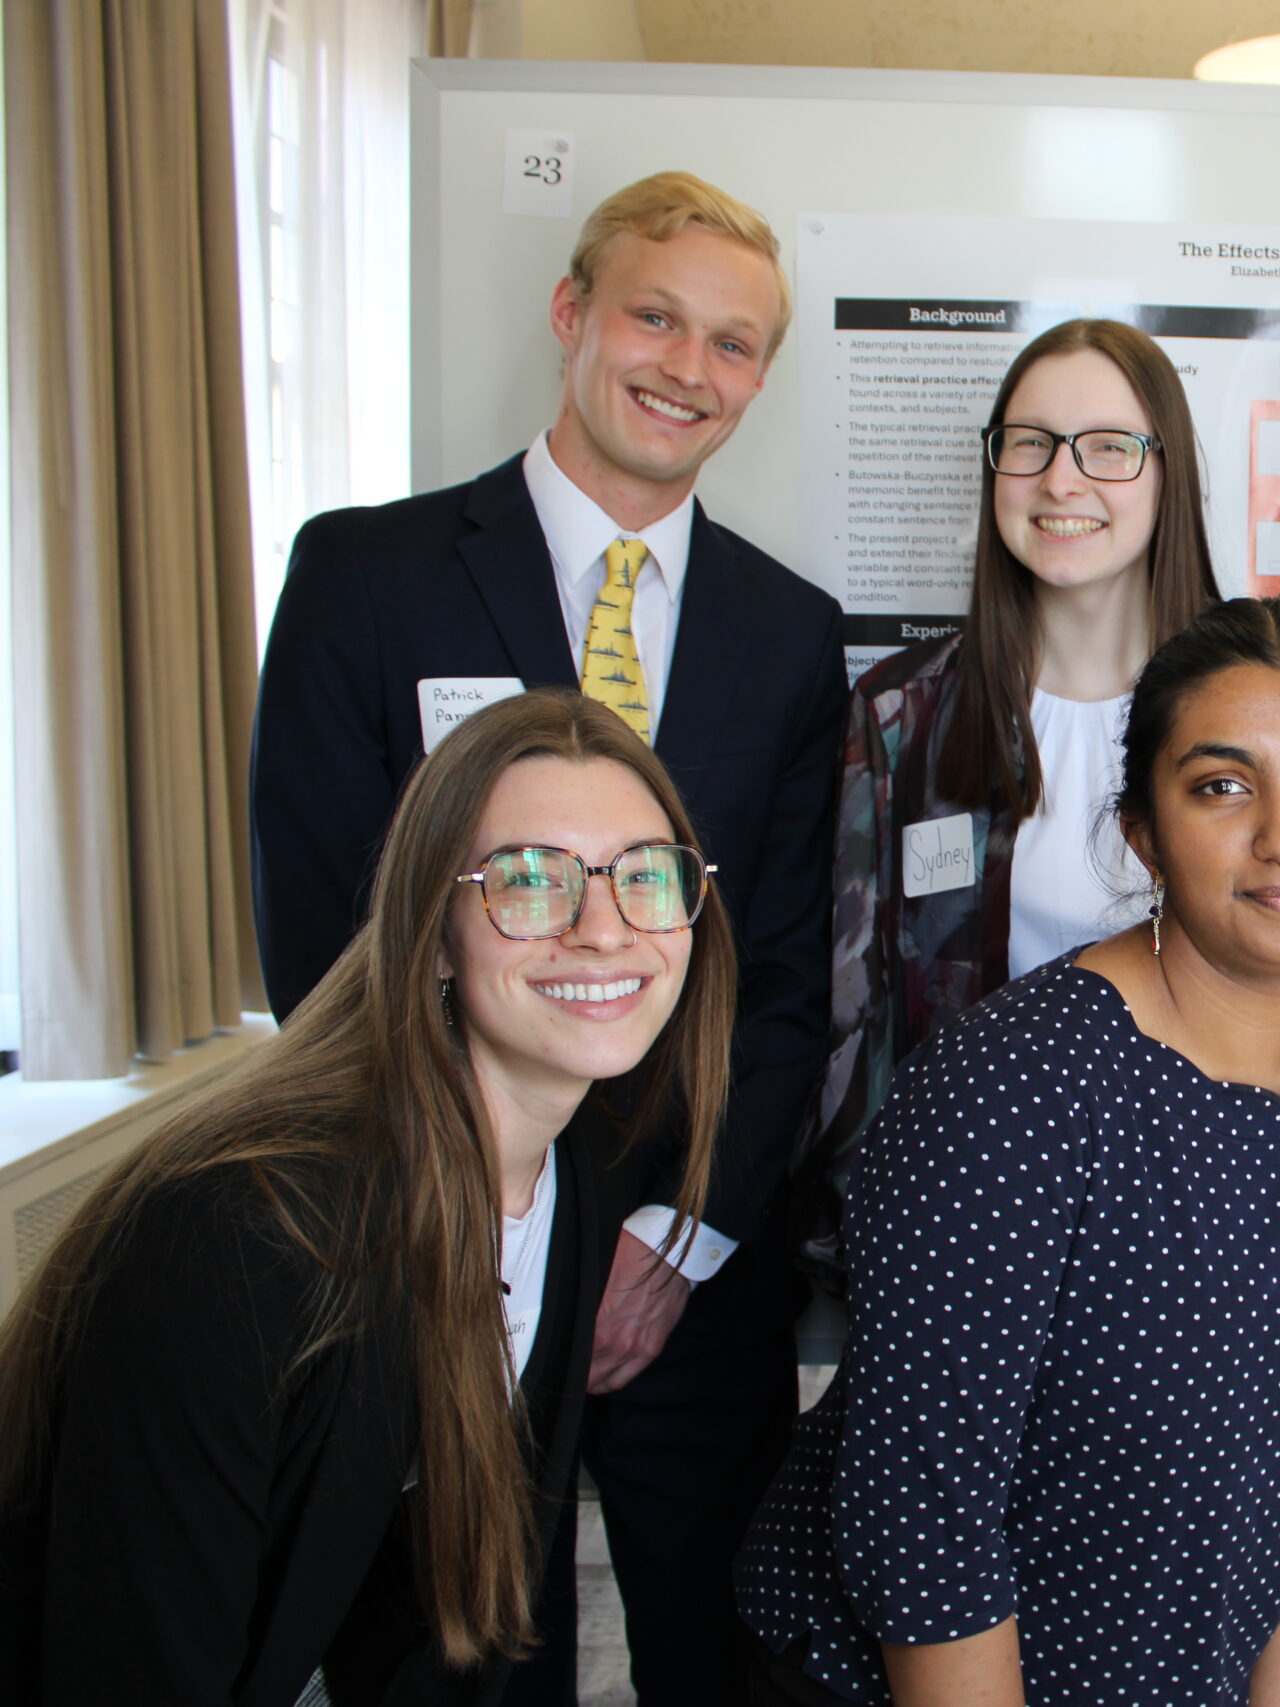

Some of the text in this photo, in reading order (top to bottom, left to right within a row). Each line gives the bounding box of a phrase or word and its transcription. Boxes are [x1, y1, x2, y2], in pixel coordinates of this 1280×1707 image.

[523, 155, 561, 186] 23
[1179, 241, 1213, 257] The
[1218, 243, 1279, 260] Effects
[910, 306, 1006, 325] Background
[850, 340, 1023, 352] Attempting to retrieve informatio
[850, 355, 897, 365] retention
[900, 356, 954, 368] compared
[956, 356, 967, 365] to
[850, 373, 870, 383] This
[874, 373, 920, 384] retrieval
[923, 375, 968, 386] practice
[849, 388, 879, 398] found
[882, 390, 918, 398] across
[929, 389, 964, 401] variety
[967, 390, 976, 399] of
[849, 403, 970, 415] contexts, and subjects.
[849, 421, 867, 431] The
[870, 421, 905, 433] typical
[908, 422, 951, 433] retrieval
[849, 437, 867, 446] the
[869, 438, 897, 446] same
[900, 437, 942, 447] retrieval
[945, 439, 965, 448] cue
[849, 451, 977, 462] repetition of the retrieval
[963, 473, 972, 481] et
[848, 486, 904, 495] mnemonic
[907, 486, 944, 496] benefit
[947, 486, 960, 496] for
[848, 500, 972, 512] with changing sentence
[848, 515, 894, 524] constant
[897, 516, 946, 525] sentence
[848, 533, 866, 543] The
[869, 535, 909, 544] present
[912, 535, 950, 545] project
[848, 548, 867, 557] and
[870, 549, 906, 558] extend
[908, 549, 931, 559] their
[848, 563, 889, 573] variable
[891, 564, 912, 573] and
[914, 564, 961, 574] constant
[847, 577, 859, 586] to
[869, 577, 905, 588] typical
[907, 577, 959, 589] word-only
[847, 592, 901, 602] condition.
[433, 687, 484, 702] Patrick
[909, 825, 971, 890] Sydney
